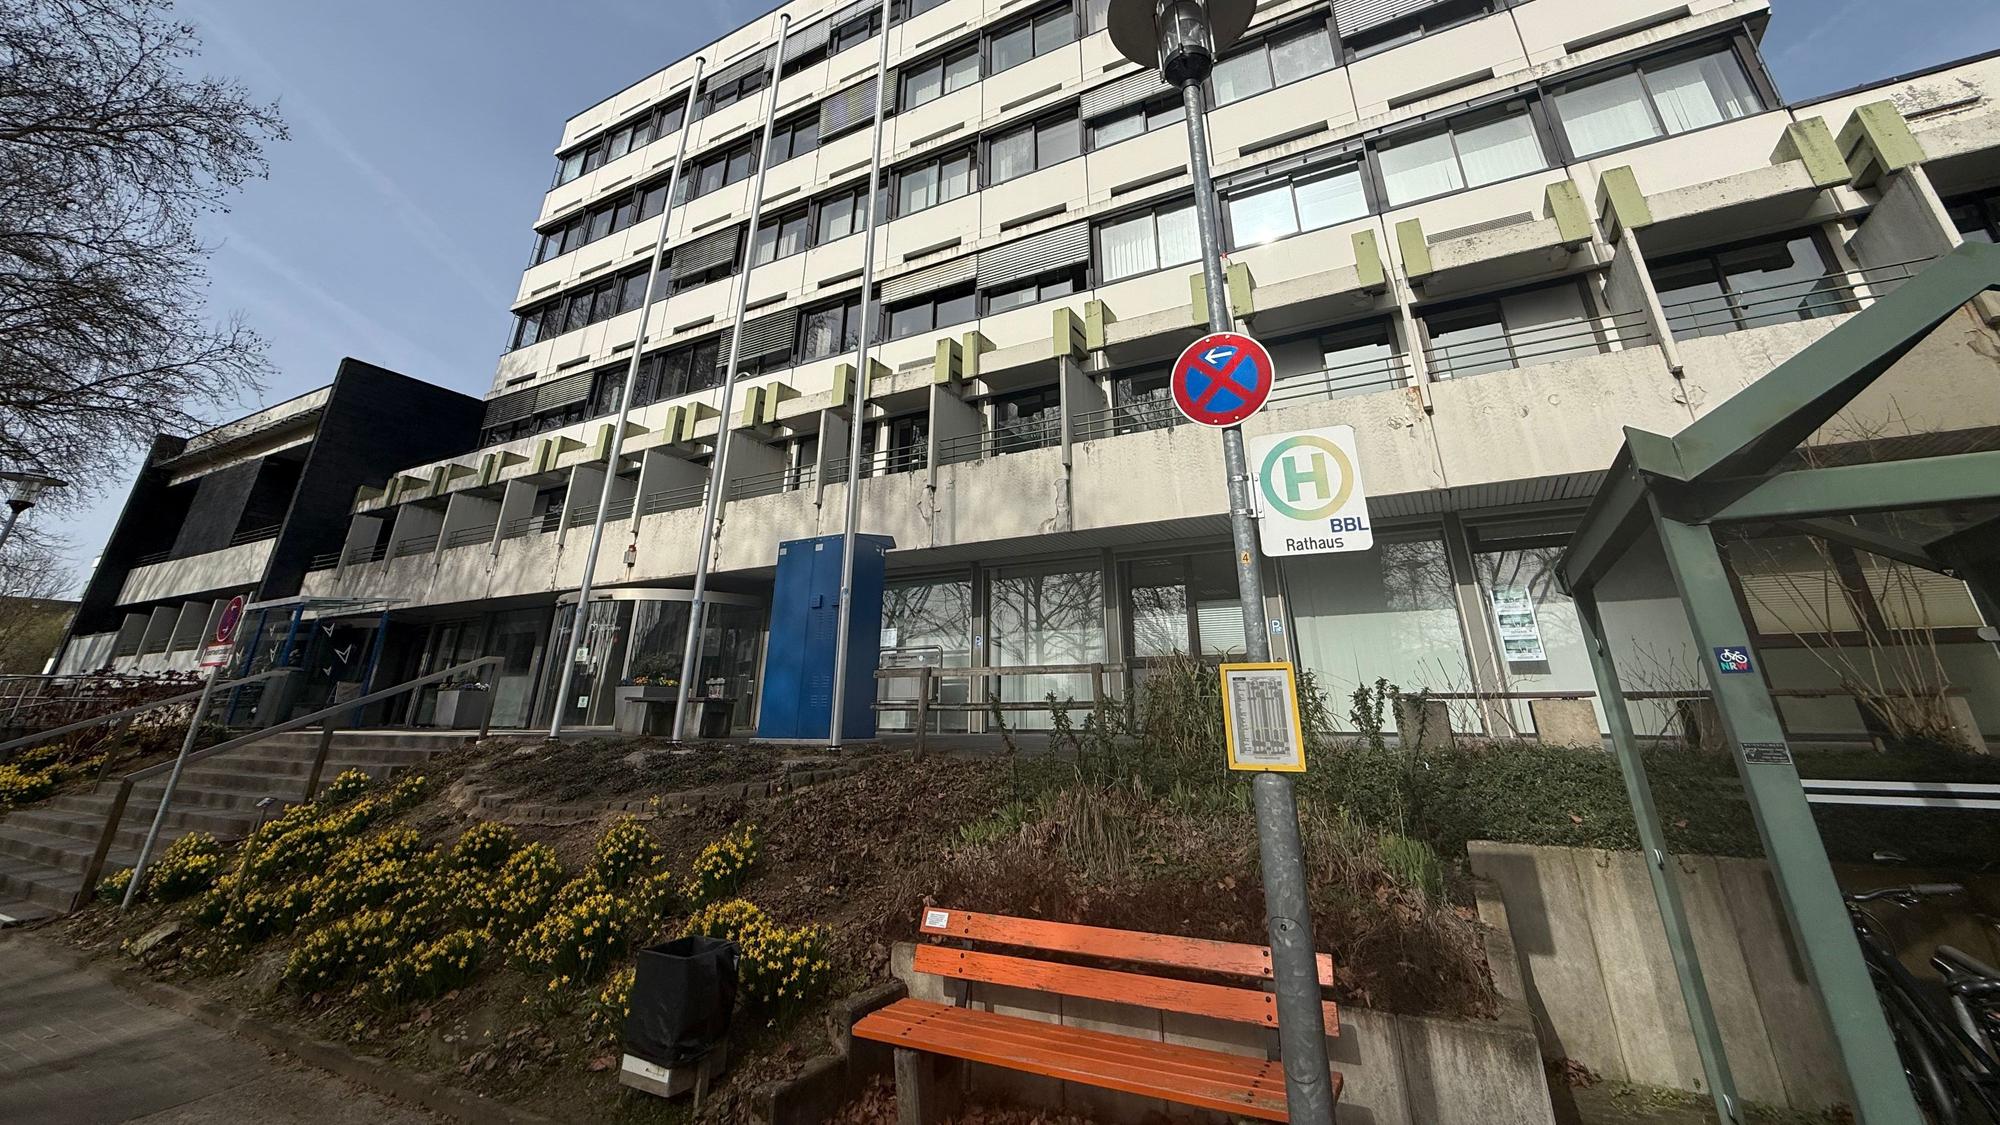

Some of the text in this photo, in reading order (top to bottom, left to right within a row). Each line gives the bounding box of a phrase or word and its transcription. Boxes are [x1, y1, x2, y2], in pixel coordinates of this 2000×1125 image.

[1282, 452, 1331, 502] H
[1330, 516, 1369, 533] BBL
[1286, 537, 1344, 551] Rathaus
[1720, 662, 1748, 670] NRW
